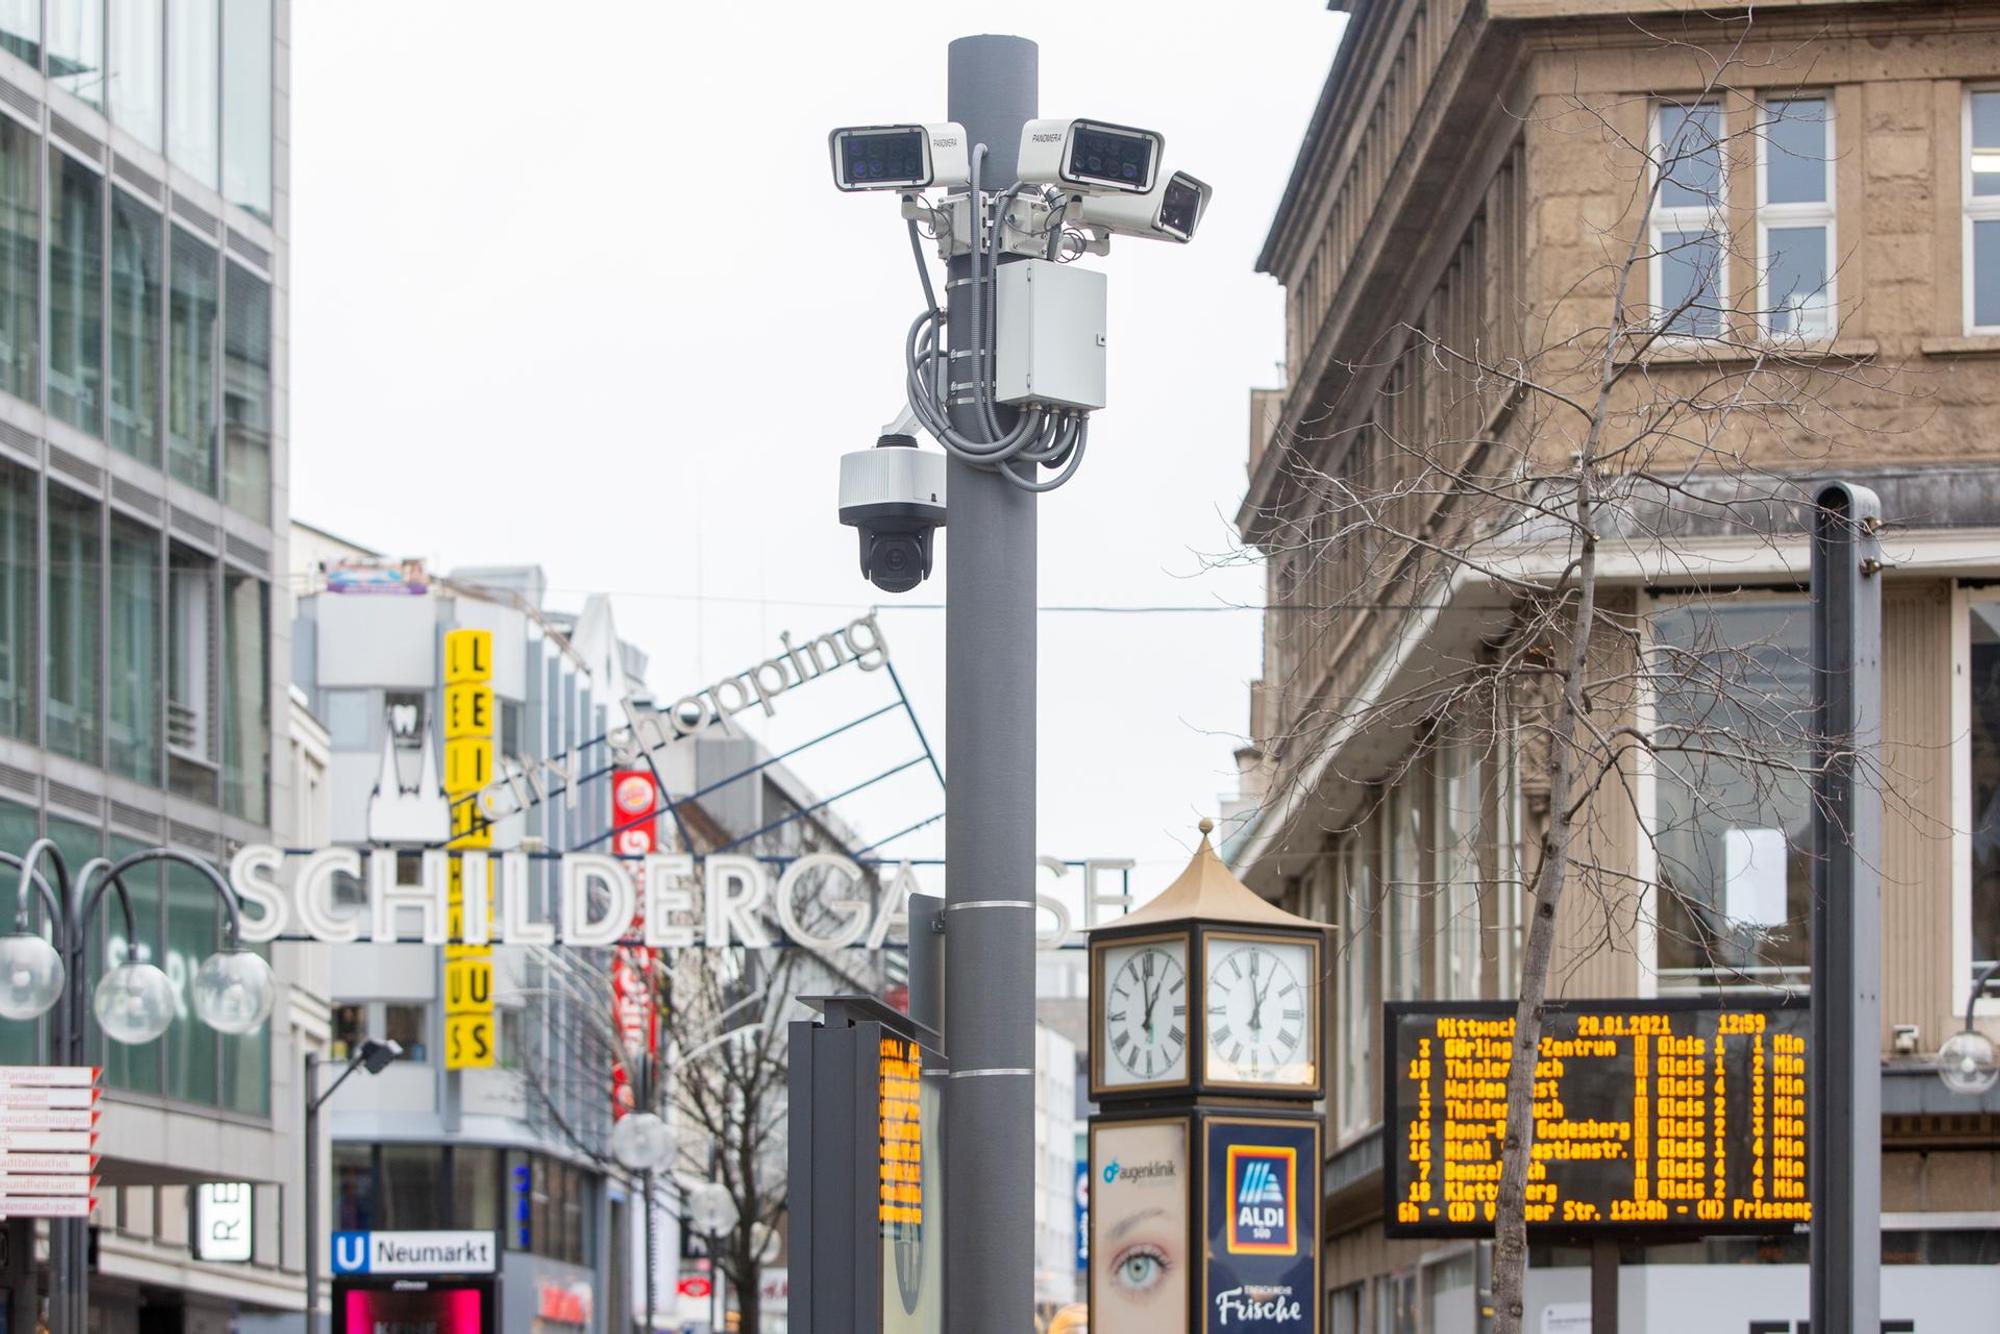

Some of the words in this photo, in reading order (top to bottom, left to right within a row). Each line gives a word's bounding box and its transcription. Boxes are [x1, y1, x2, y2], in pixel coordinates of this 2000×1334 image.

[1032, 133, 1062, 143] PANOMERA
[604, 609, 890, 767] shopping
[229, 843, 1136, 949] SCHILDERGASE
[1437, 1018, 1515, 1038] Mittwoch
[1578, 1015, 1671, 1036] 20.01.2021
[1718, 1014, 1766, 1035] 12:59
[1419, 1039, 1431, 1058] 3
[1657, 1036, 1705, 1055] Gleis
[1714, 1035, 1726, 1055] 1
[1753, 1034, 1765, 1054] 1
[1773, 1034, 1805, 1054] Min
[1409, 1059, 1431, 1079] 18
[1445, 1058, 1563, 1079] Thielenuch
[1657, 1056, 1705, 1075] Gleis
[1714, 1056, 1726, 1075] 1
[1753, 1055, 1765, 1074] 2
[1773, 1055, 1805, 1074] Min
[1419, 1080, 1431, 1099] 1
[1445, 1080, 1505, 1098] Weiden
[1657, 1077, 1705, 1096] Gleis
[1714, 1077, 1726, 1095] 4
[1753, 1076, 1765, 1095] 3
[1773, 1076, 1805, 1095] Min
[1419, 1100, 1431, 1119] 3
[1657, 1097, 1705, 1117] Gleis
[1714, 1097, 1726, 1116] 2
[1753, 1096, 1765, 1116] 3
[1773, 1096, 1805, 1116] Min
[1409, 1121, 1431, 1140] 16
[1445, 1120, 1507, 1140] Bonn-B
[1537, 1119, 1630, 1141] Godesberg
[1657, 1118, 1705, 1137] Gleis
[1714, 1117, 1726, 1137] 2
[1753, 1117, 1765, 1136] 3
[1773, 1117, 1805, 1136] Min
[1409, 1141, 1431, 1160] 16
[1445, 1141, 1491, 1160] Niehl
[1657, 1138, 1705, 1158] Gleis
[1714, 1138, 1726, 1157] 1
[1753, 1137, 1765, 1157] 4
[1773, 1137, 1805, 1157] Min
[1119, 1160, 1176, 1184] augenklinik
[1419, 1161, 1431, 1181] 7
[1657, 1159, 1705, 1178] Gleis
[1714, 1159, 1726, 1178] 4
[1753, 1158, 1765, 1177] 4
[1773, 1158, 1805, 1177] Min
[1409, 1182, 1431, 1201] 18
[1657, 1179, 1705, 1199] Gleis
[1714, 1179, 1726, 1198] 2
[1753, 1179, 1765, 1198] 6
[1773, 1179, 1805, 1198] Min
[1239, 1206, 1284, 1227] ALDI
[1564, 1201, 1601, 1221] Str.
[337, 1236, 365, 1271] U
[378, 1240, 487, 1263] Neumarkt
[1216, 1287, 1302, 1326] Frische
